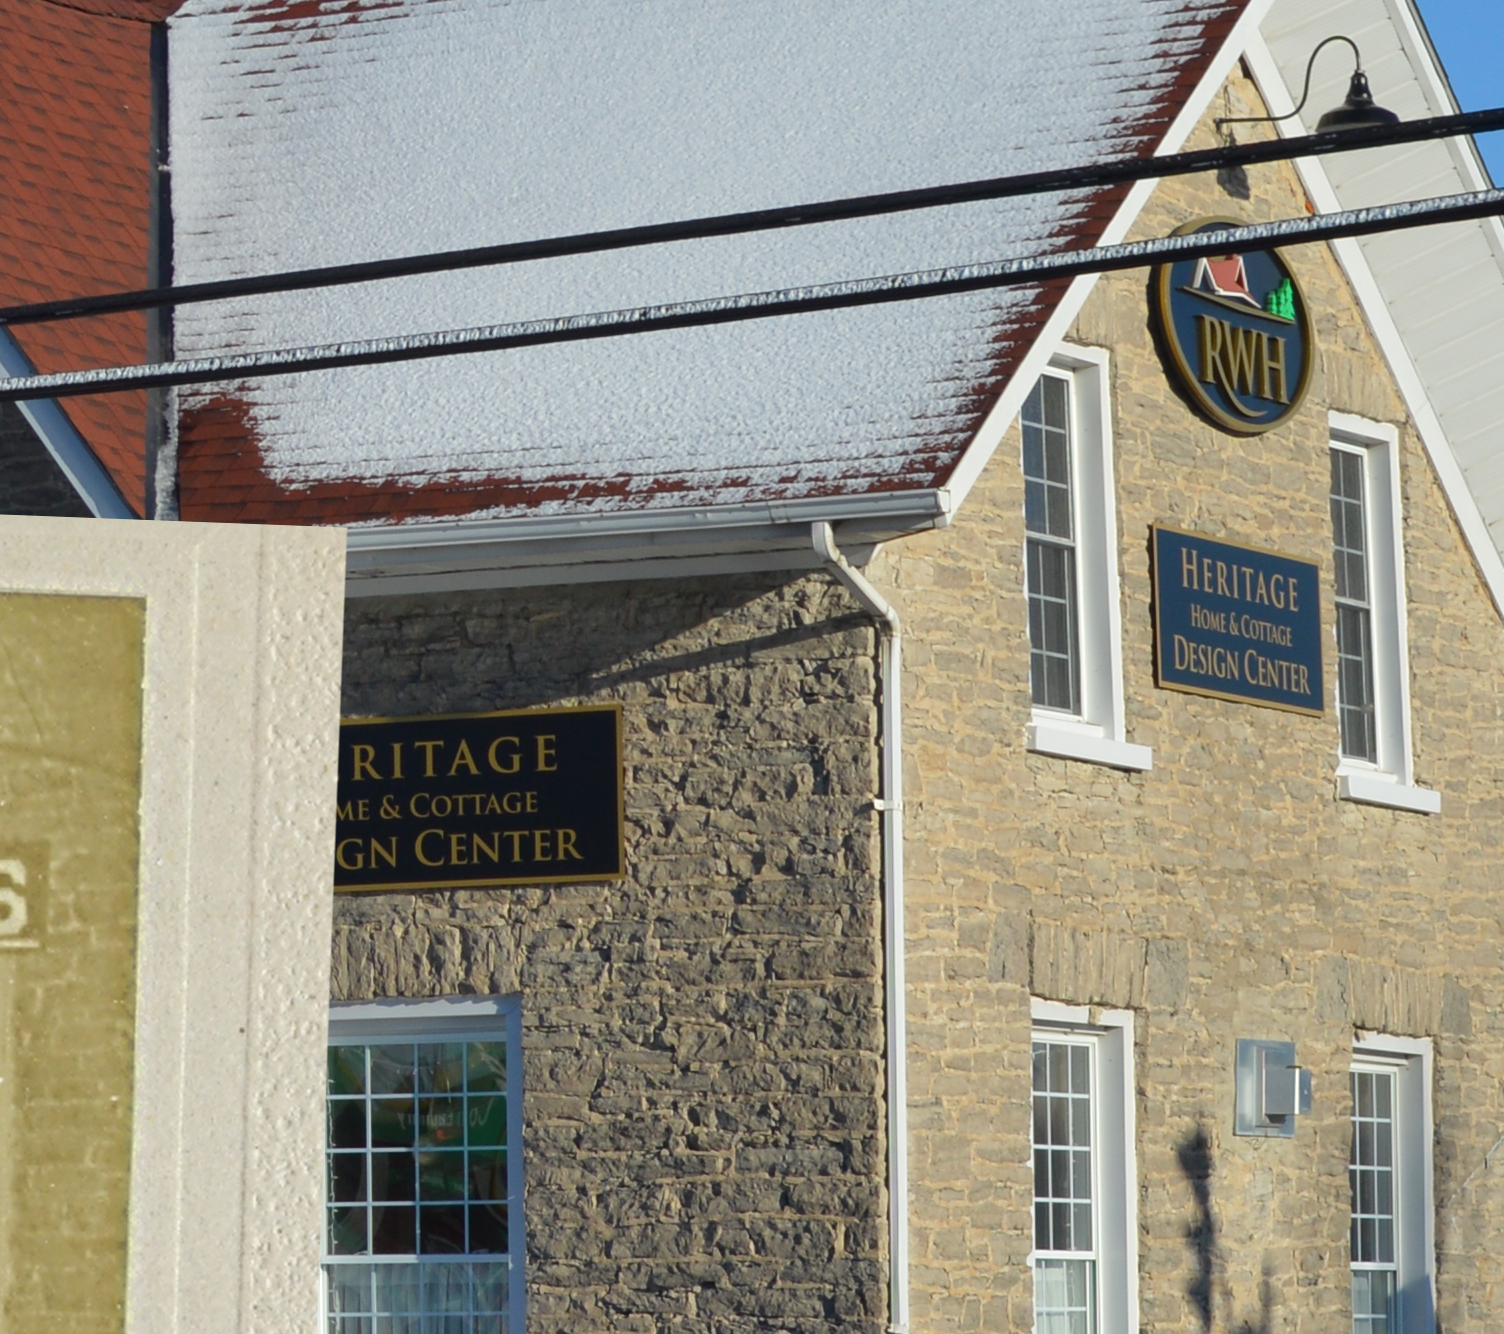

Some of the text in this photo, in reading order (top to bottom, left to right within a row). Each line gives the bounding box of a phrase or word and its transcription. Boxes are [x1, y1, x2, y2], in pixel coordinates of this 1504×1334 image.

[1200, 314, 1291, 417] RWH
[1181, 547, 1299, 612] HERITAGE
[1191, 603, 1293, 647] HOME & COTTAGE
[1173, 634, 1312, 695] DESIGN CENTER
[379, 794, 403, 820] &
[409, 791, 538, 818] COTTAGE
[414, 828, 585, 867] CENTER
